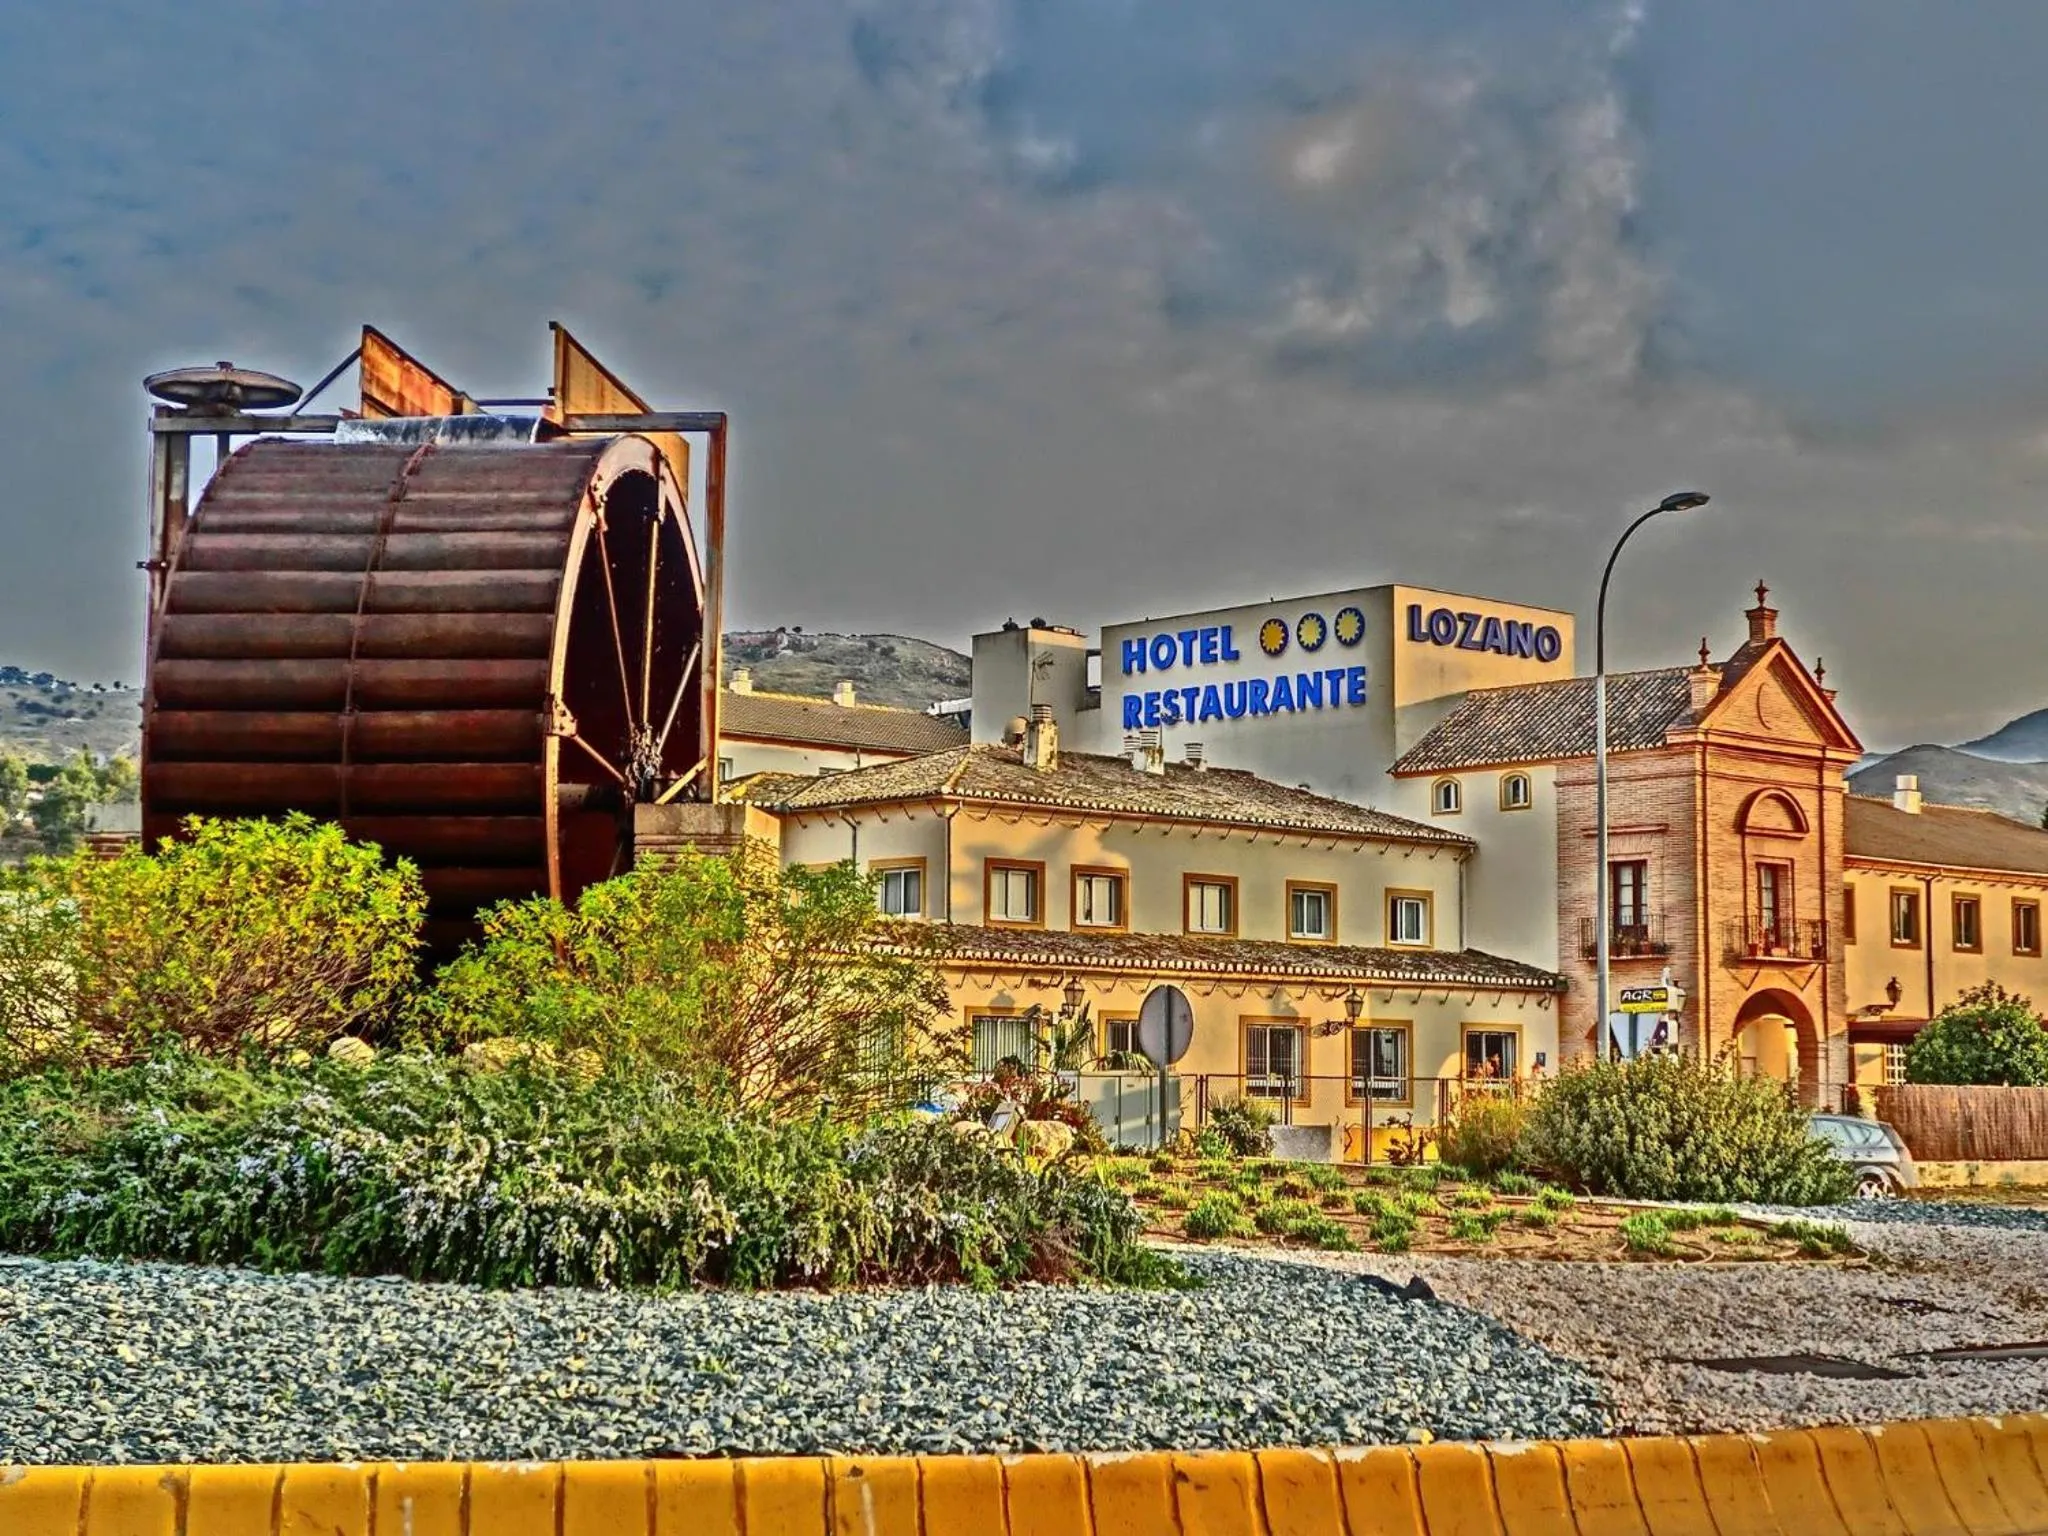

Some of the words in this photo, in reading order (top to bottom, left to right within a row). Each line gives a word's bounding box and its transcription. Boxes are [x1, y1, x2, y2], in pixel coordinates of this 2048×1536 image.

[1122, 625, 1239, 674] HOTEL
[1408, 604, 1562, 662] LOZANO
[1122, 666, 1367, 729] RESTAURANTE
